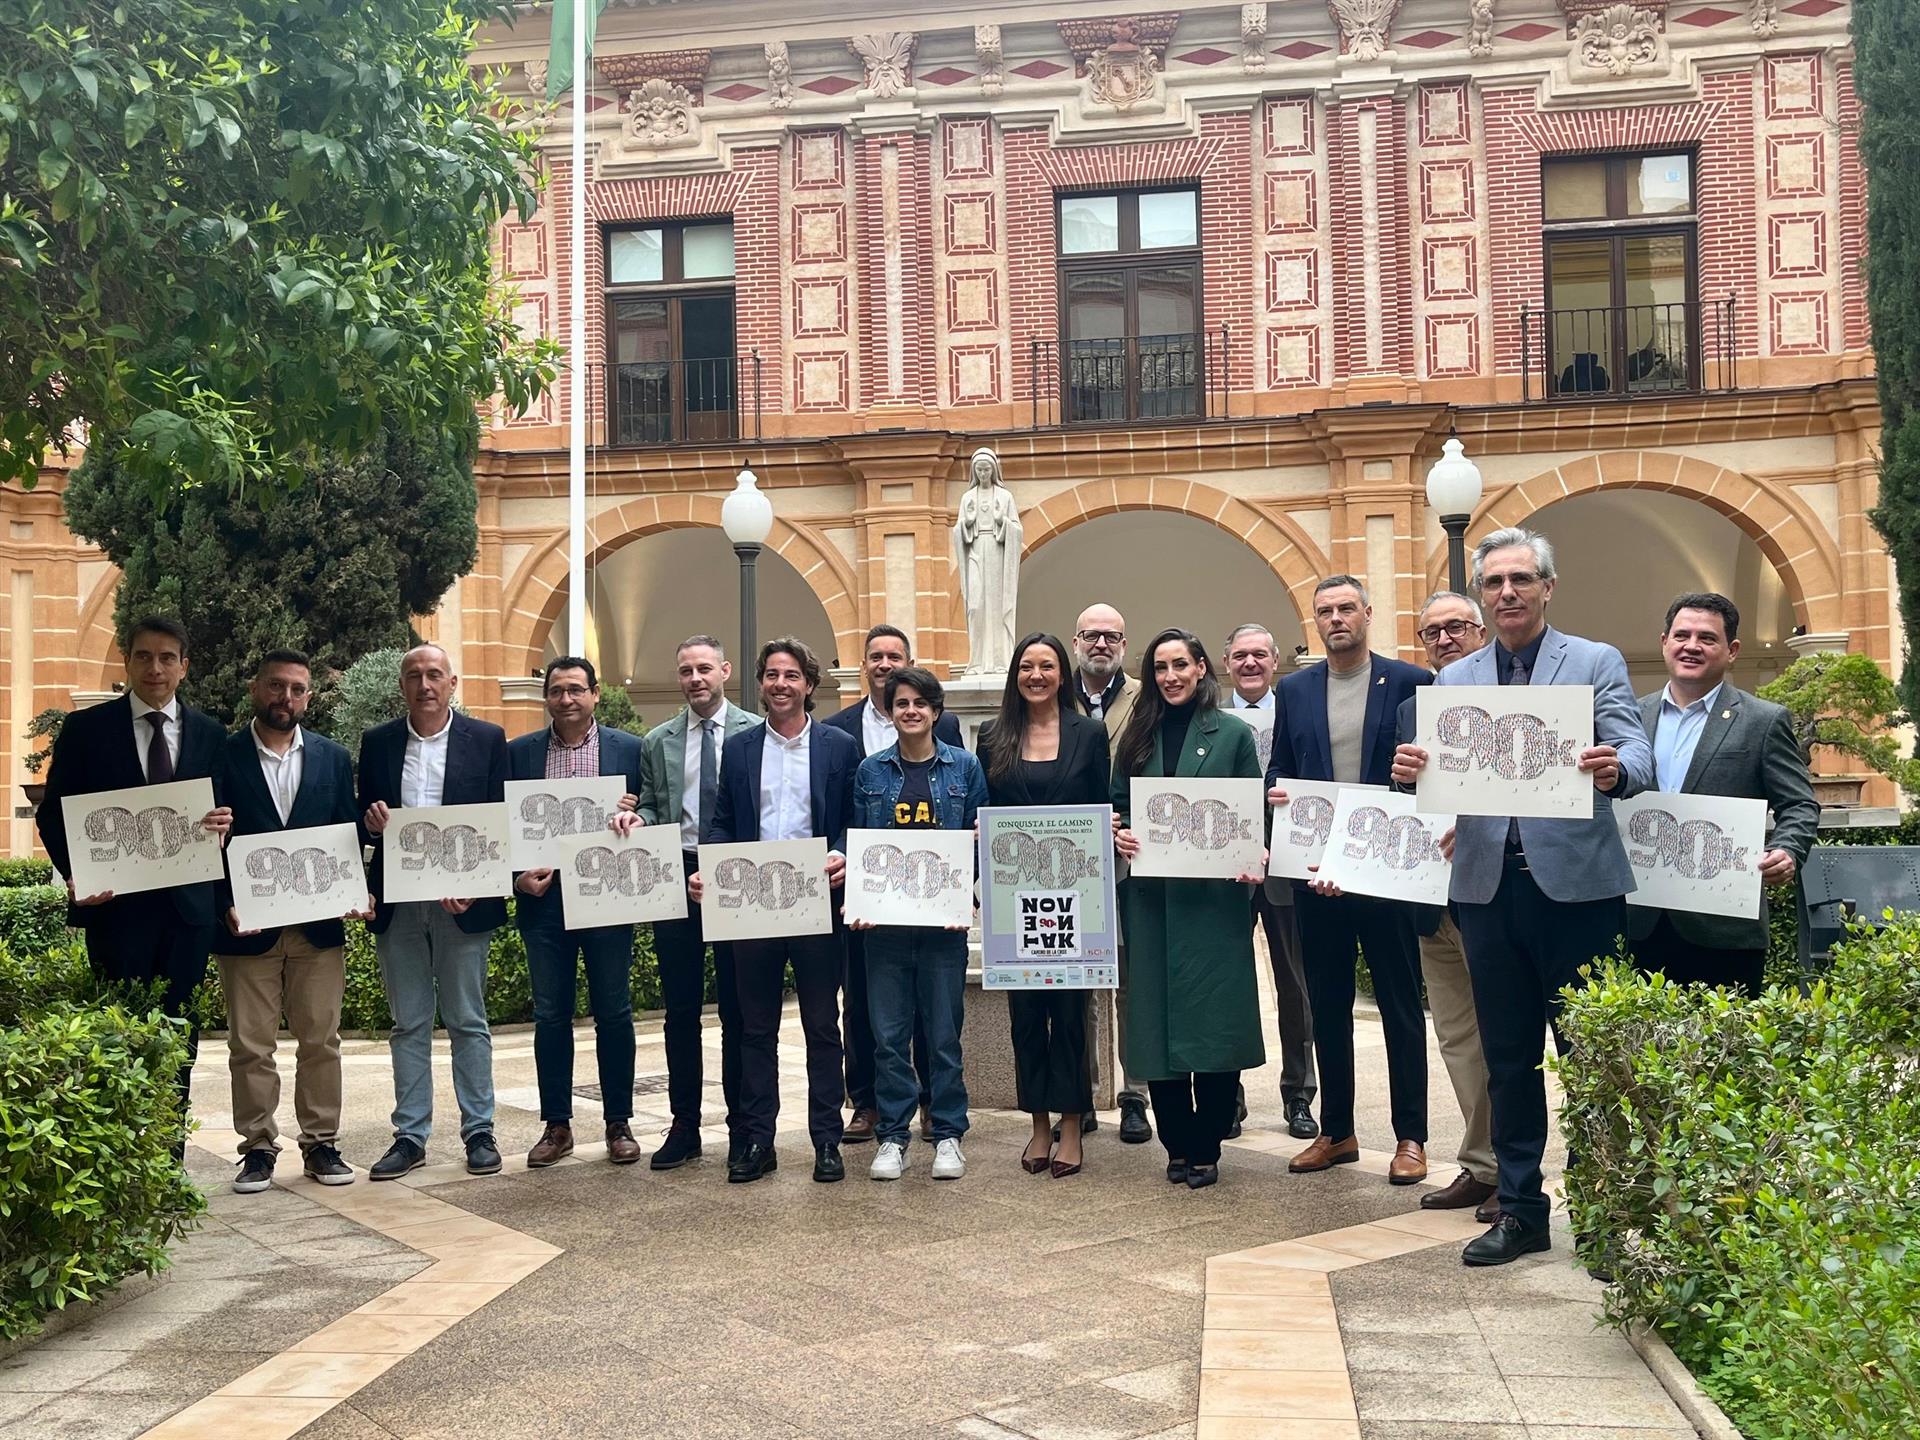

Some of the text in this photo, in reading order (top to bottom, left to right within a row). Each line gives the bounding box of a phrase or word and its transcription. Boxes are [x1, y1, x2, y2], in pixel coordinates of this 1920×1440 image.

[1437, 705, 1577, 779] 90k
[895, 801, 936, 824] CA
[997, 820, 1044, 831] CONQUISTA
[1058, 819, 1093, 827] CAMINO
[1146, 792, 1251, 851] 90k
[400, 821, 500, 872] 90k
[991, 831, 1099, 889] 90k
[1629, 808, 1748, 880] 90k
[246, 847, 353, 897] 90k
[576, 846, 673, 897] 90k
[715, 857, 818, 910] 90k
[862, 843, 962, 899] 90k
[1022, 897, 1073, 913] NOV
